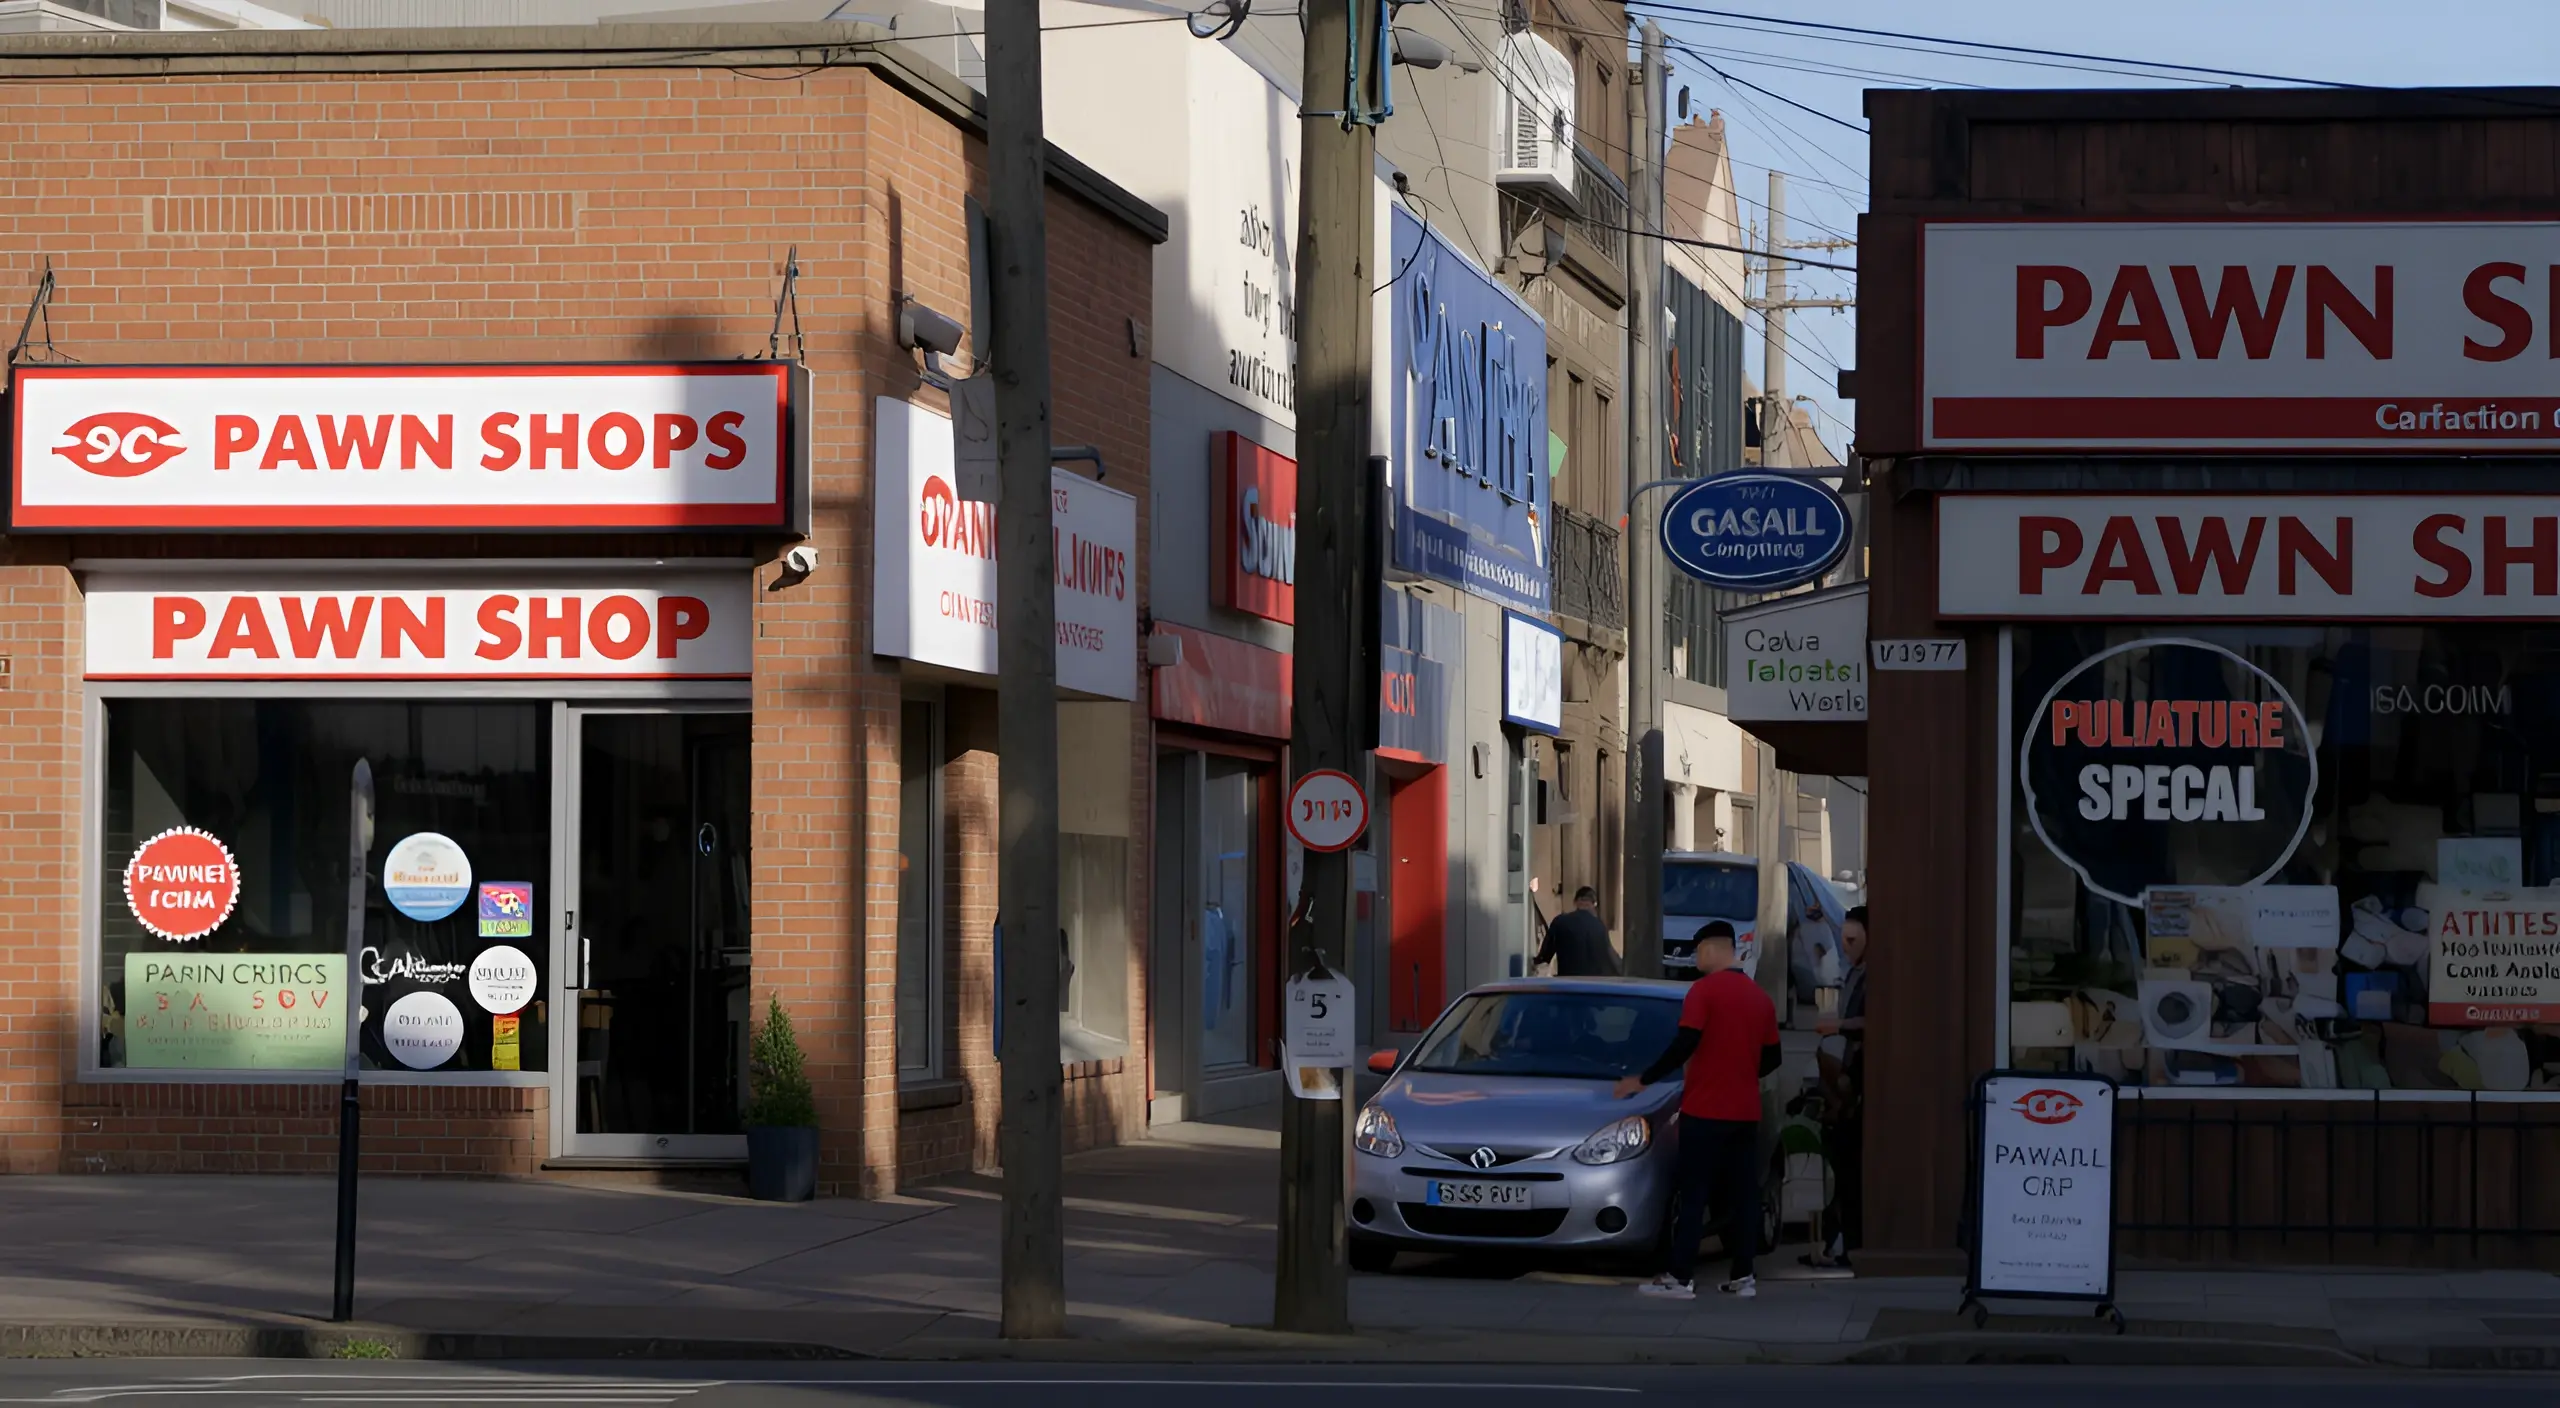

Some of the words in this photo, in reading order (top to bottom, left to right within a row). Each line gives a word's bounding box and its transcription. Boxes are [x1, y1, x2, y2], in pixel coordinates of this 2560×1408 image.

[2015, 264, 2395, 360] PAWN
[2462, 261, 2560, 363] S
[214, 413, 453, 470] PAWN
[480, 410, 748, 472] SHOPS
[1690, 506, 1826, 538] GASALL
[2018, 515, 2354, 597] PAWN
[151, 596, 446, 659] PAWN
[474, 593, 711, 661] SHOP
[2078, 763, 2266, 823] SPECAL
[1310, 993, 1328, 1019] 5
